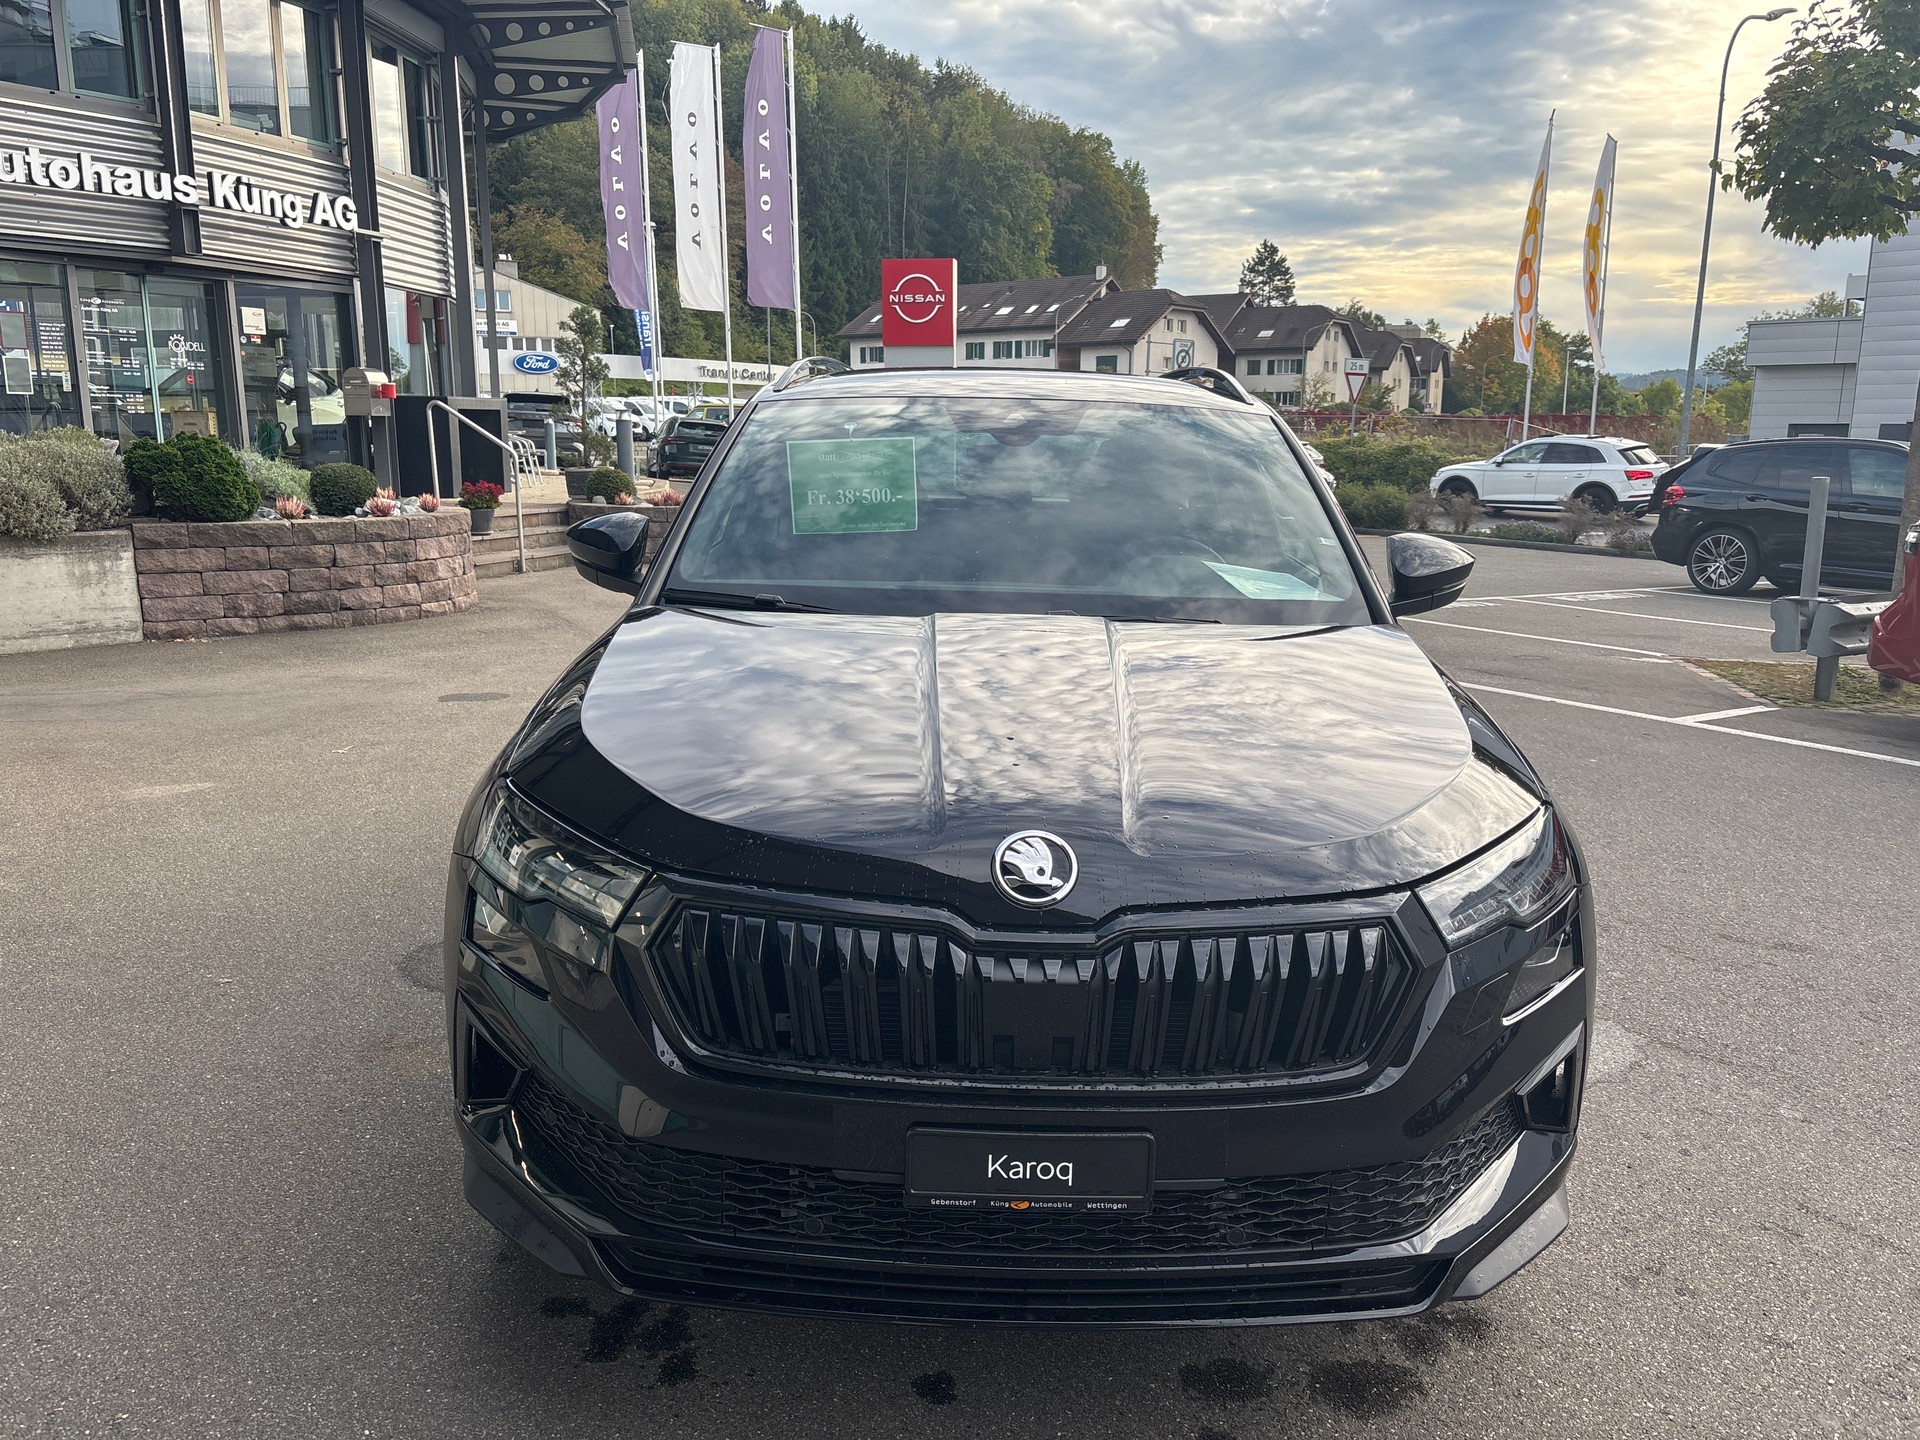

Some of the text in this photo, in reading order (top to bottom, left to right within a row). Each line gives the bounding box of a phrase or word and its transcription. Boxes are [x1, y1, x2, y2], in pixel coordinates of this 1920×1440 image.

[0, 146, 359, 231] utohaus Küng AG
[889, 294, 945, 303] NISSAN
[523, 355, 551, 370] Ford
[1350, 362, 1358, 370] 25
[741, 368, 777, 381] Center
[817, 453, 837, 462] statt
[807, 490, 831, 505] Fr.
[987, 1154, 1073, 1187] Karoq
[930, 1198, 977, 1206] Gebenstorf
[990, 1200, 1010, 1208] Küng
[1087, 1202, 1128, 1210] Wettingen
